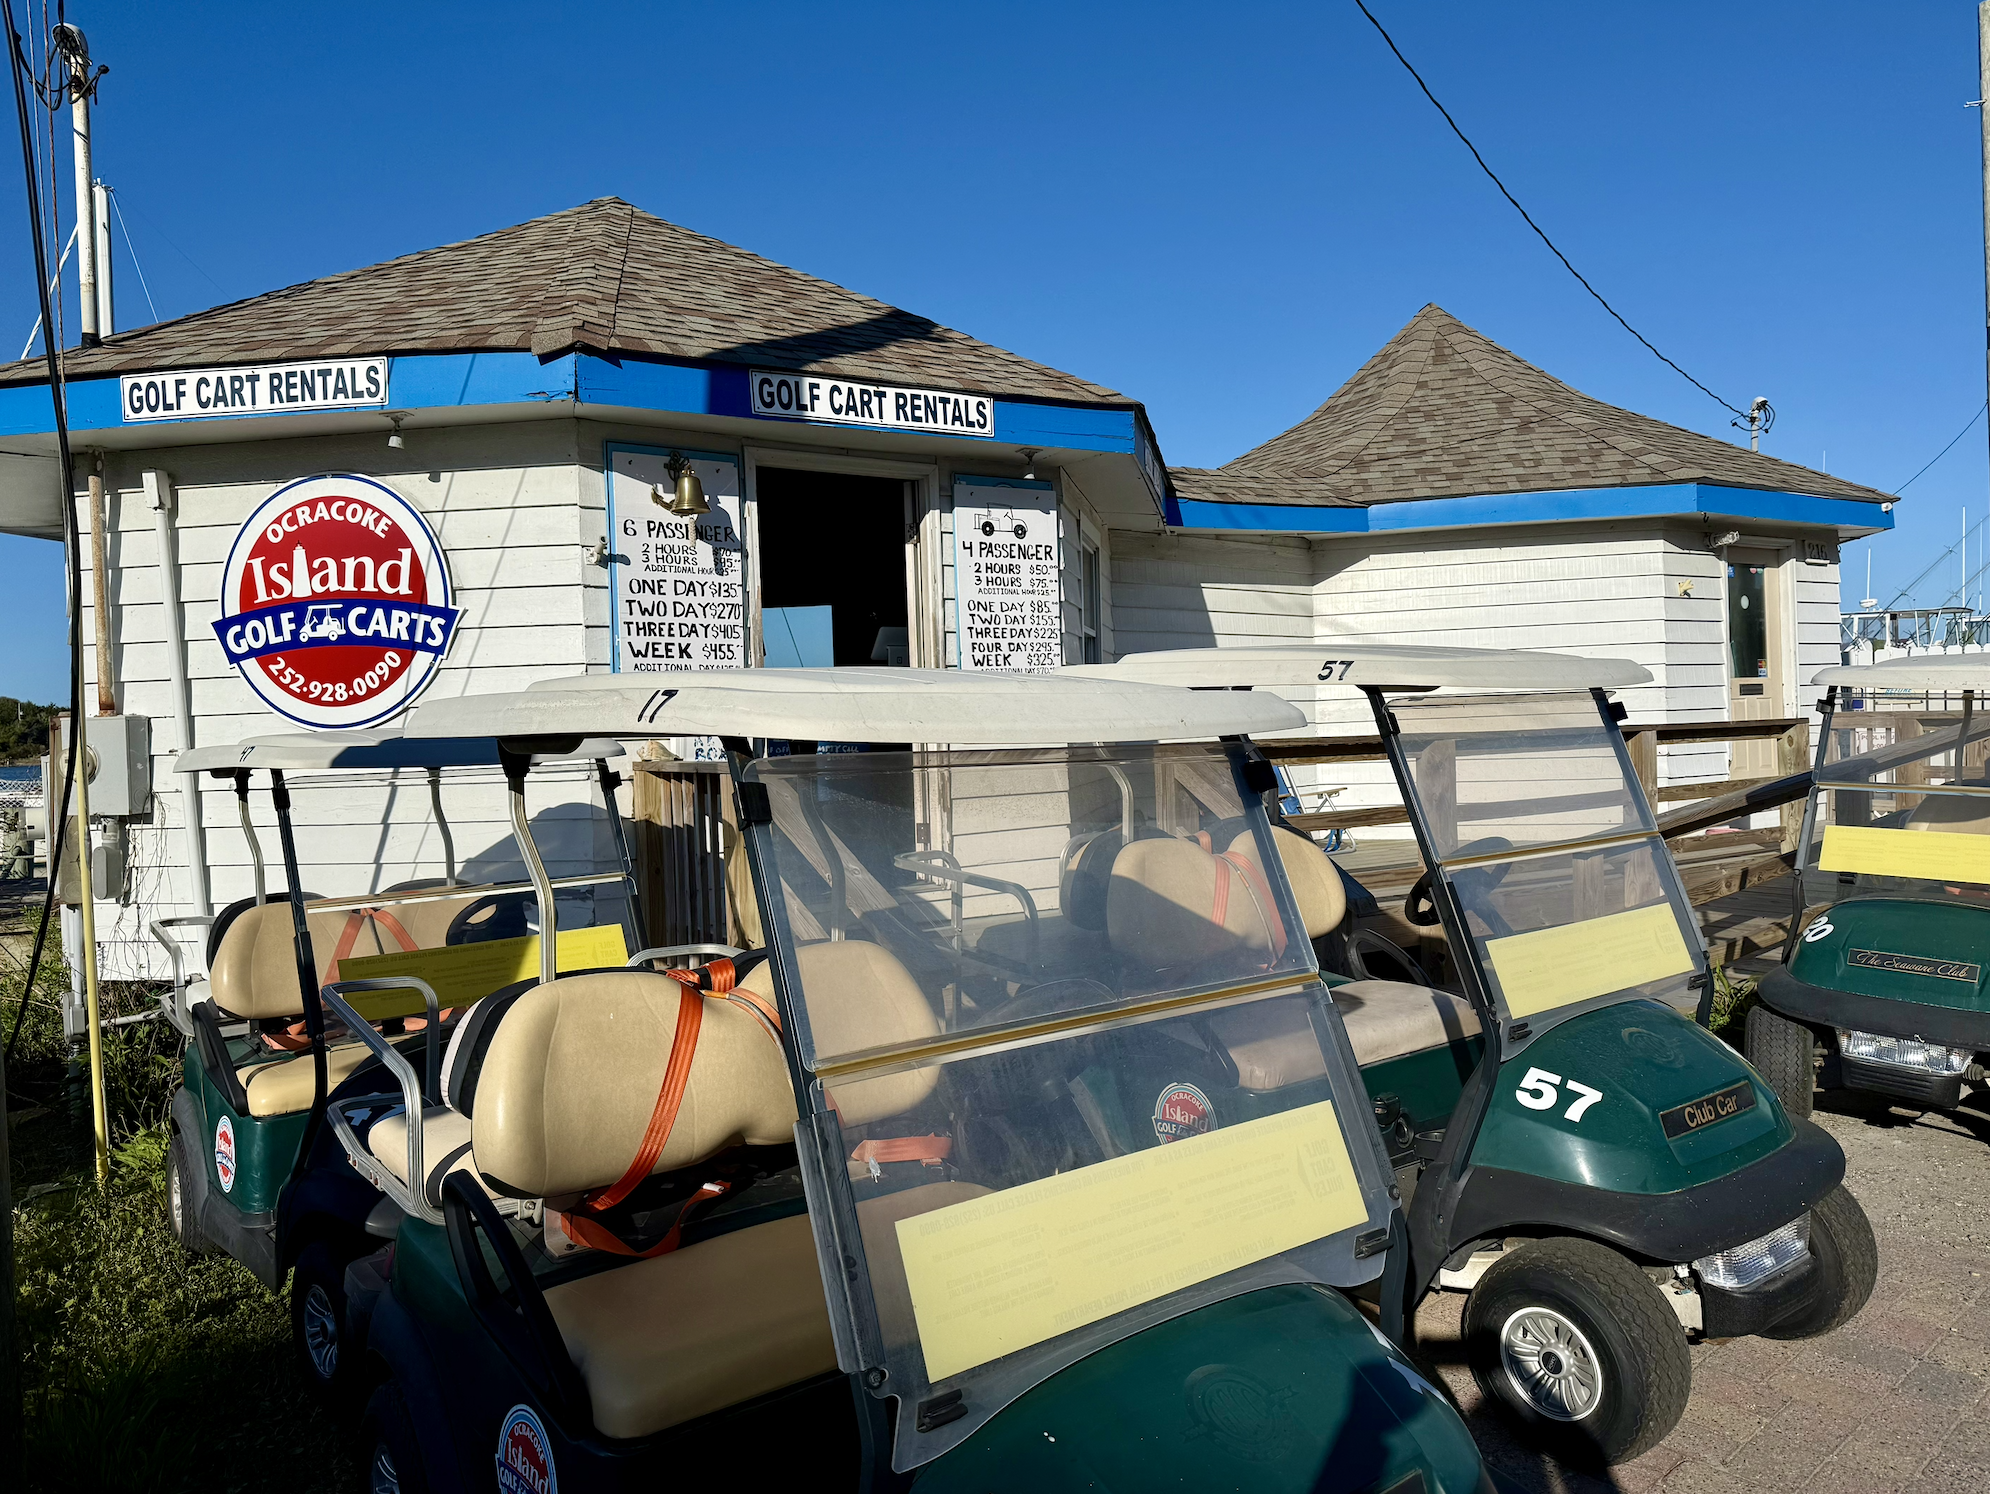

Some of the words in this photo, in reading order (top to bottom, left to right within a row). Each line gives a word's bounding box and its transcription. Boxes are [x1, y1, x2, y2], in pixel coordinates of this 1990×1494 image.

[128, 378, 187, 414] GOLF
[196, 374, 260, 409] CART
[269, 365, 381, 405] RENTALS
[758, 377, 821, 412] GOLF
[828, 384, 887, 420] CART
[895, 391, 988, 430] RENTALS
[266, 501, 393, 544] OCRACOKE
[623, 518, 637, 537] 6
[641, 543, 650, 553] 2
[655, 543, 698, 556] HOURS
[962, 541, 973, 558] 4
[979, 541, 1054, 561] PASSENGER
[641, 553, 650, 563] 3
[655, 554, 698, 566] HOURS
[644, 564, 696, 574] ADDITIONAL
[974, 563, 982, 573] 2
[985, 563, 1021, 575] HOURS
[247, 540, 413, 604] Island
[629, 578, 667, 596] ONE
[674, 579, 708, 597] DAY
[974, 576, 983, 586] 3
[986, 576, 1022, 588] HOURS
[977, 588, 1020, 596] ADDITIONAL
[625, 599, 667, 617] TWO
[673, 601, 710, 619] DAY
[967, 600, 995, 613] ONE
[1000, 601, 1026, 613] DAY
[969, 613, 1001, 626] TWO
[1004, 614, 1027, 626] DAY
[226, 611, 297, 655] GOLF
[347, 606, 447, 647] CARTS
[623, 621, 676, 638] THREE
[678, 622, 711, 639] DAY
[967, 626, 1008, 639] THREE
[1010, 627, 1033, 639] DAY
[627, 641, 693, 660] WEEK
[971, 642, 1003, 653] FOUR
[1008, 642, 1028, 652] DAY
[971, 653, 1012, 667] WEEK
[1317, 660, 1355, 681] 57
[637, 689, 680, 724] 17
[1856, 952, 1881, 966] The
[1937, 964, 1968, 978] Club
[1171, 1092, 1204, 1112] OCRACOKE
[1515, 1066, 1604, 1123] 57
[1164, 1103, 1209, 1133] Island
[1684, 1105, 1716, 1129] Club
[1718, 1094, 1738, 1115] Car
[1157, 1121, 1177, 1134] GOLF
[514, 1423, 546, 1464] OCRACOKE
[500, 1466, 518, 1491] GOLF
